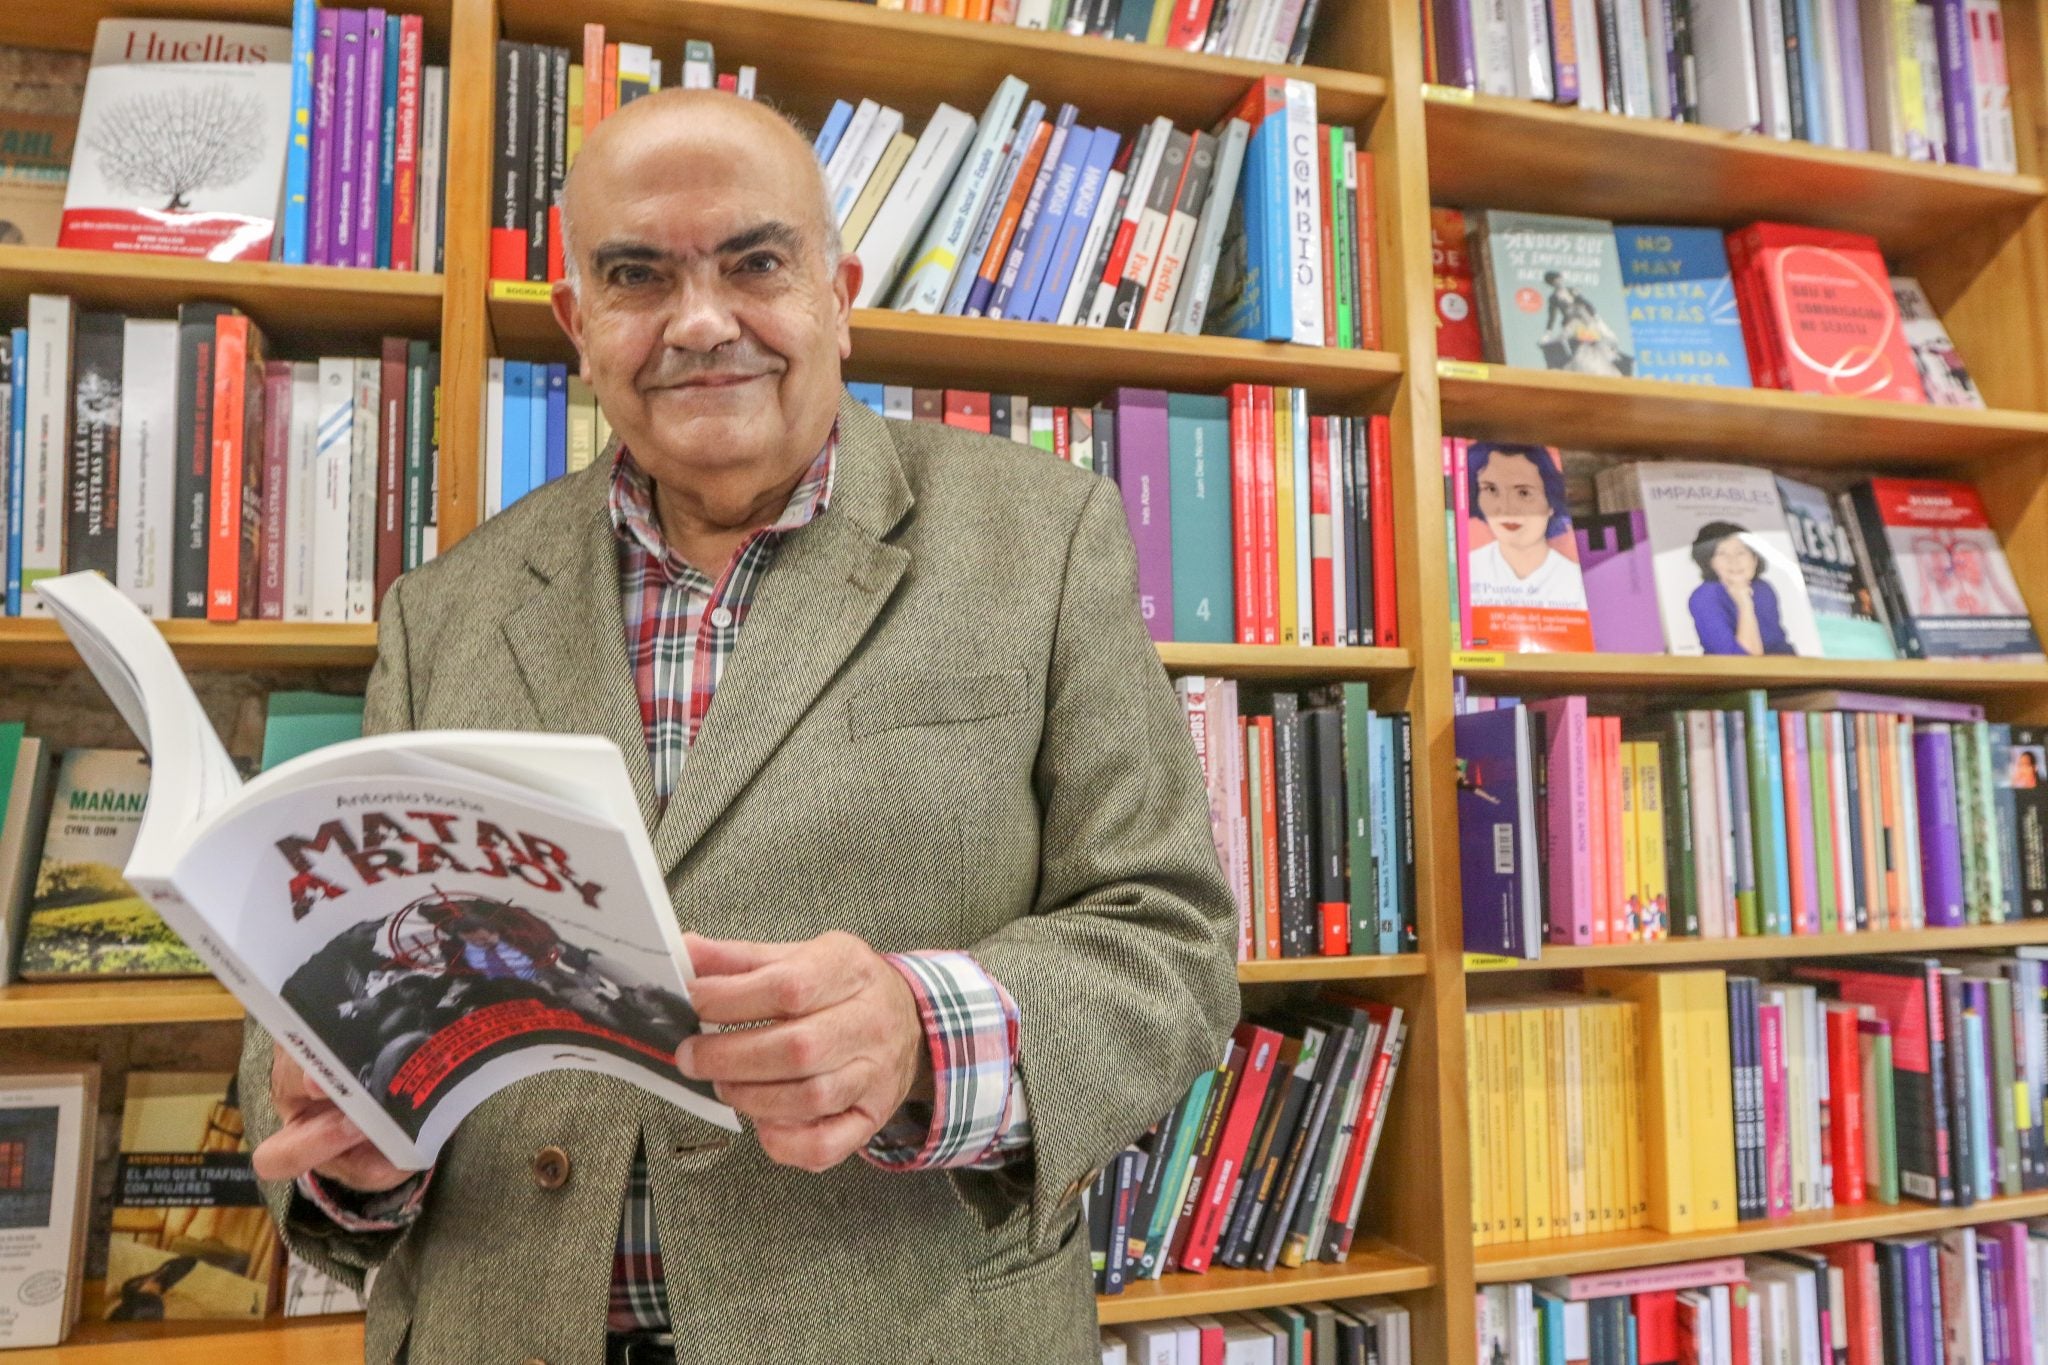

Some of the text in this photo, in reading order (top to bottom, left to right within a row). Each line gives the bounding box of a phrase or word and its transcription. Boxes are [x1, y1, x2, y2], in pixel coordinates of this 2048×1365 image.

[124, 31, 267, 65] Huellas
[403, 75, 414, 87] la
[402, 90, 414, 105] de
[398, 108, 415, 162] Historia
[958, 187, 977, 216] Social
[972, 147, 994, 179] España
[1636, 236, 1672, 252] NO
[1148, 251, 1181, 304] Facha
[1632, 260, 1682, 275] HAY
[1630, 300, 1706, 323] ATRÁS
[1640, 349, 1730, 367] ELINDA
[72, 438, 88, 476] ALLÁ
[72, 480, 87, 512] MÁS
[88, 456, 103, 535] NUESTRAS
[1195, 478, 1205, 497] Juan
[1651, 486, 1776, 505] IMPARABLES
[265, 541, 280, 588] CLAUDE
[1484, 582, 1523, 594] Puntos
[1141, 595, 1155, 620] 5
[1196, 598, 1211, 621] 4
[274, 811, 577, 882] MATAR
[288, 841, 605, 922] A RAJOY
[127, 1165, 258, 1182] EL AÑO QUE TRAFIQU
[124, 1181, 211, 1194] CON MUJERES
[1182, 1175, 1202, 1217] LA INDIA
